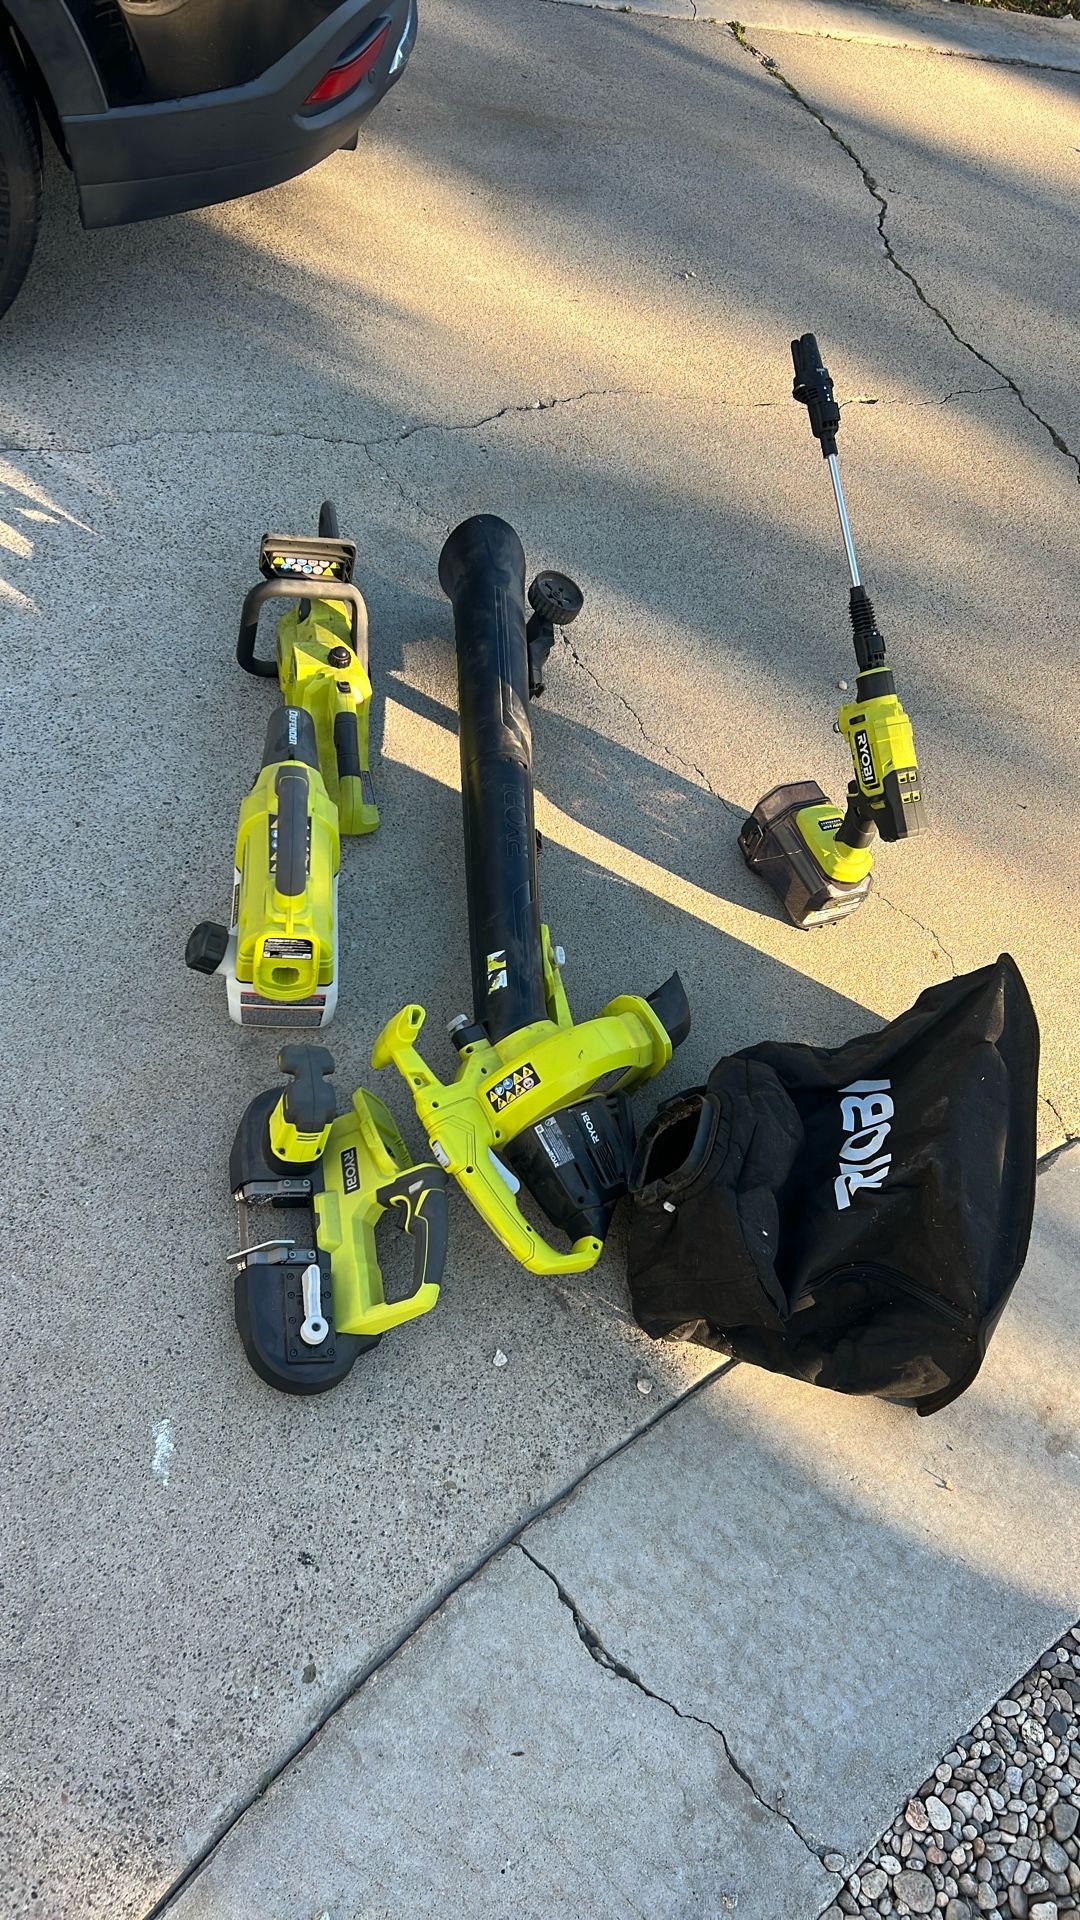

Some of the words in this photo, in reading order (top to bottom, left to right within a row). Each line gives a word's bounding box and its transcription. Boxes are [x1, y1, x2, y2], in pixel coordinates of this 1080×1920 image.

[288, 710, 298, 745] DEFENDER
[857, 733, 873, 781] RYOBI
[581, 1112, 599, 1145] RYOBI
[343, 1151, 357, 1191] RYOBI
